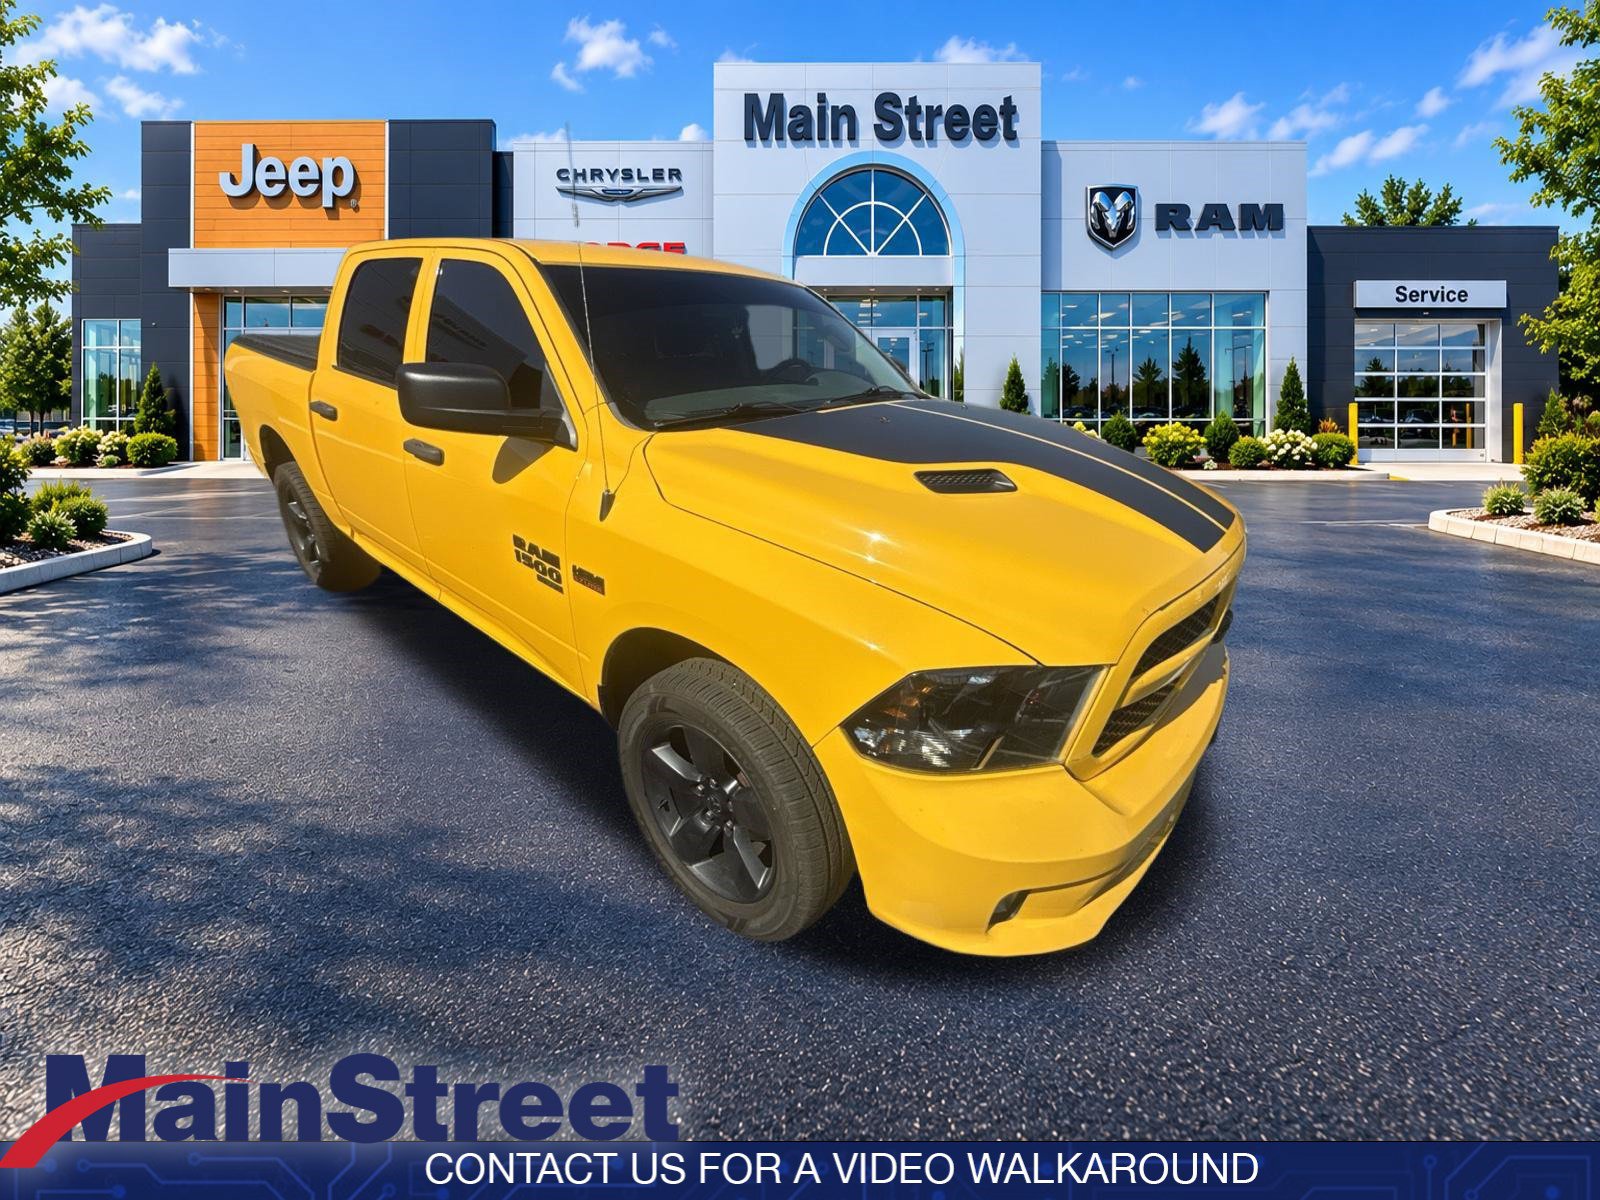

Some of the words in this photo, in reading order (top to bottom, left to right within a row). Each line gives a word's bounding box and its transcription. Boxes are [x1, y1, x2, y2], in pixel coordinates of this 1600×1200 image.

[744, 92, 857, 142] Main
[873, 91, 1018, 143] Street
[218, 143, 355, 208] Jeep
[556, 168, 683, 182] CHRYSLER
[1155, 203, 1284, 231] RAM
[1395, 285, 1469, 303] Service
